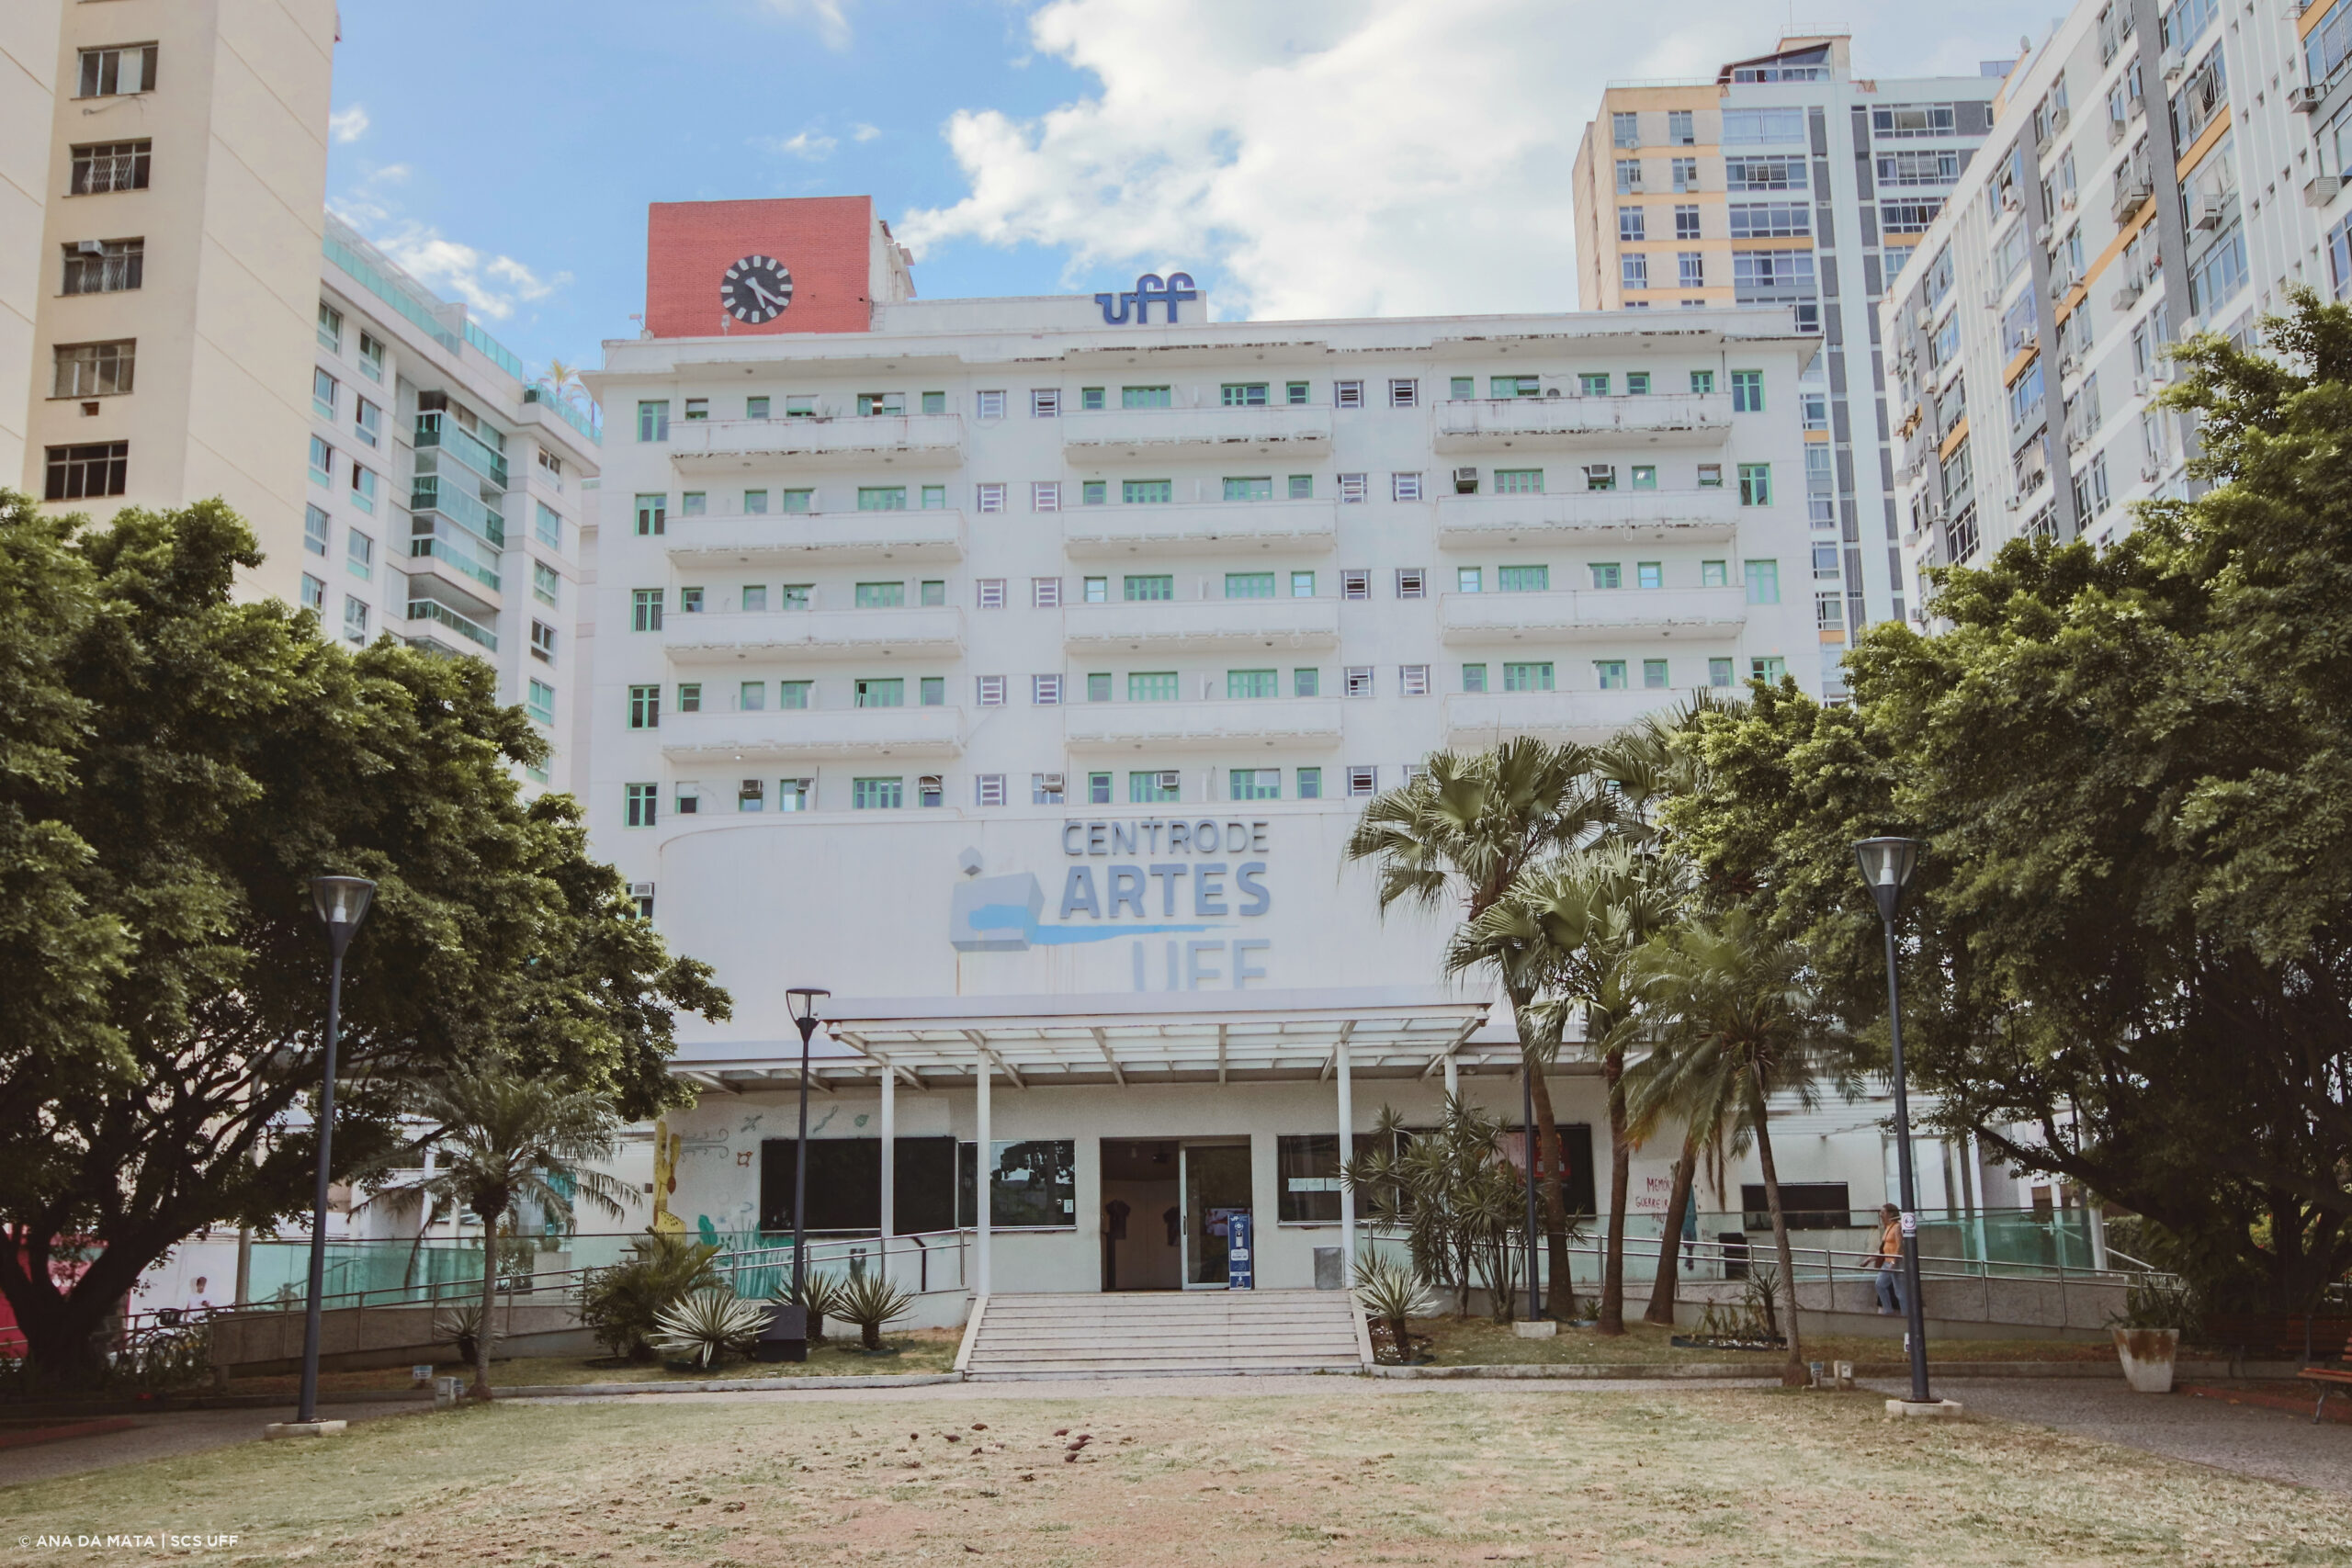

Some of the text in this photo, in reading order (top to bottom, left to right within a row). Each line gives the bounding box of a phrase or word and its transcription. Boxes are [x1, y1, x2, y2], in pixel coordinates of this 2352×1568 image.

[1094, 272, 1197, 325] uff
[1061, 819, 1270, 856] CENTRO DE
[1059, 862, 1271, 919] ARTES
[1635, 1196, 1669, 1210] GUERREIR
